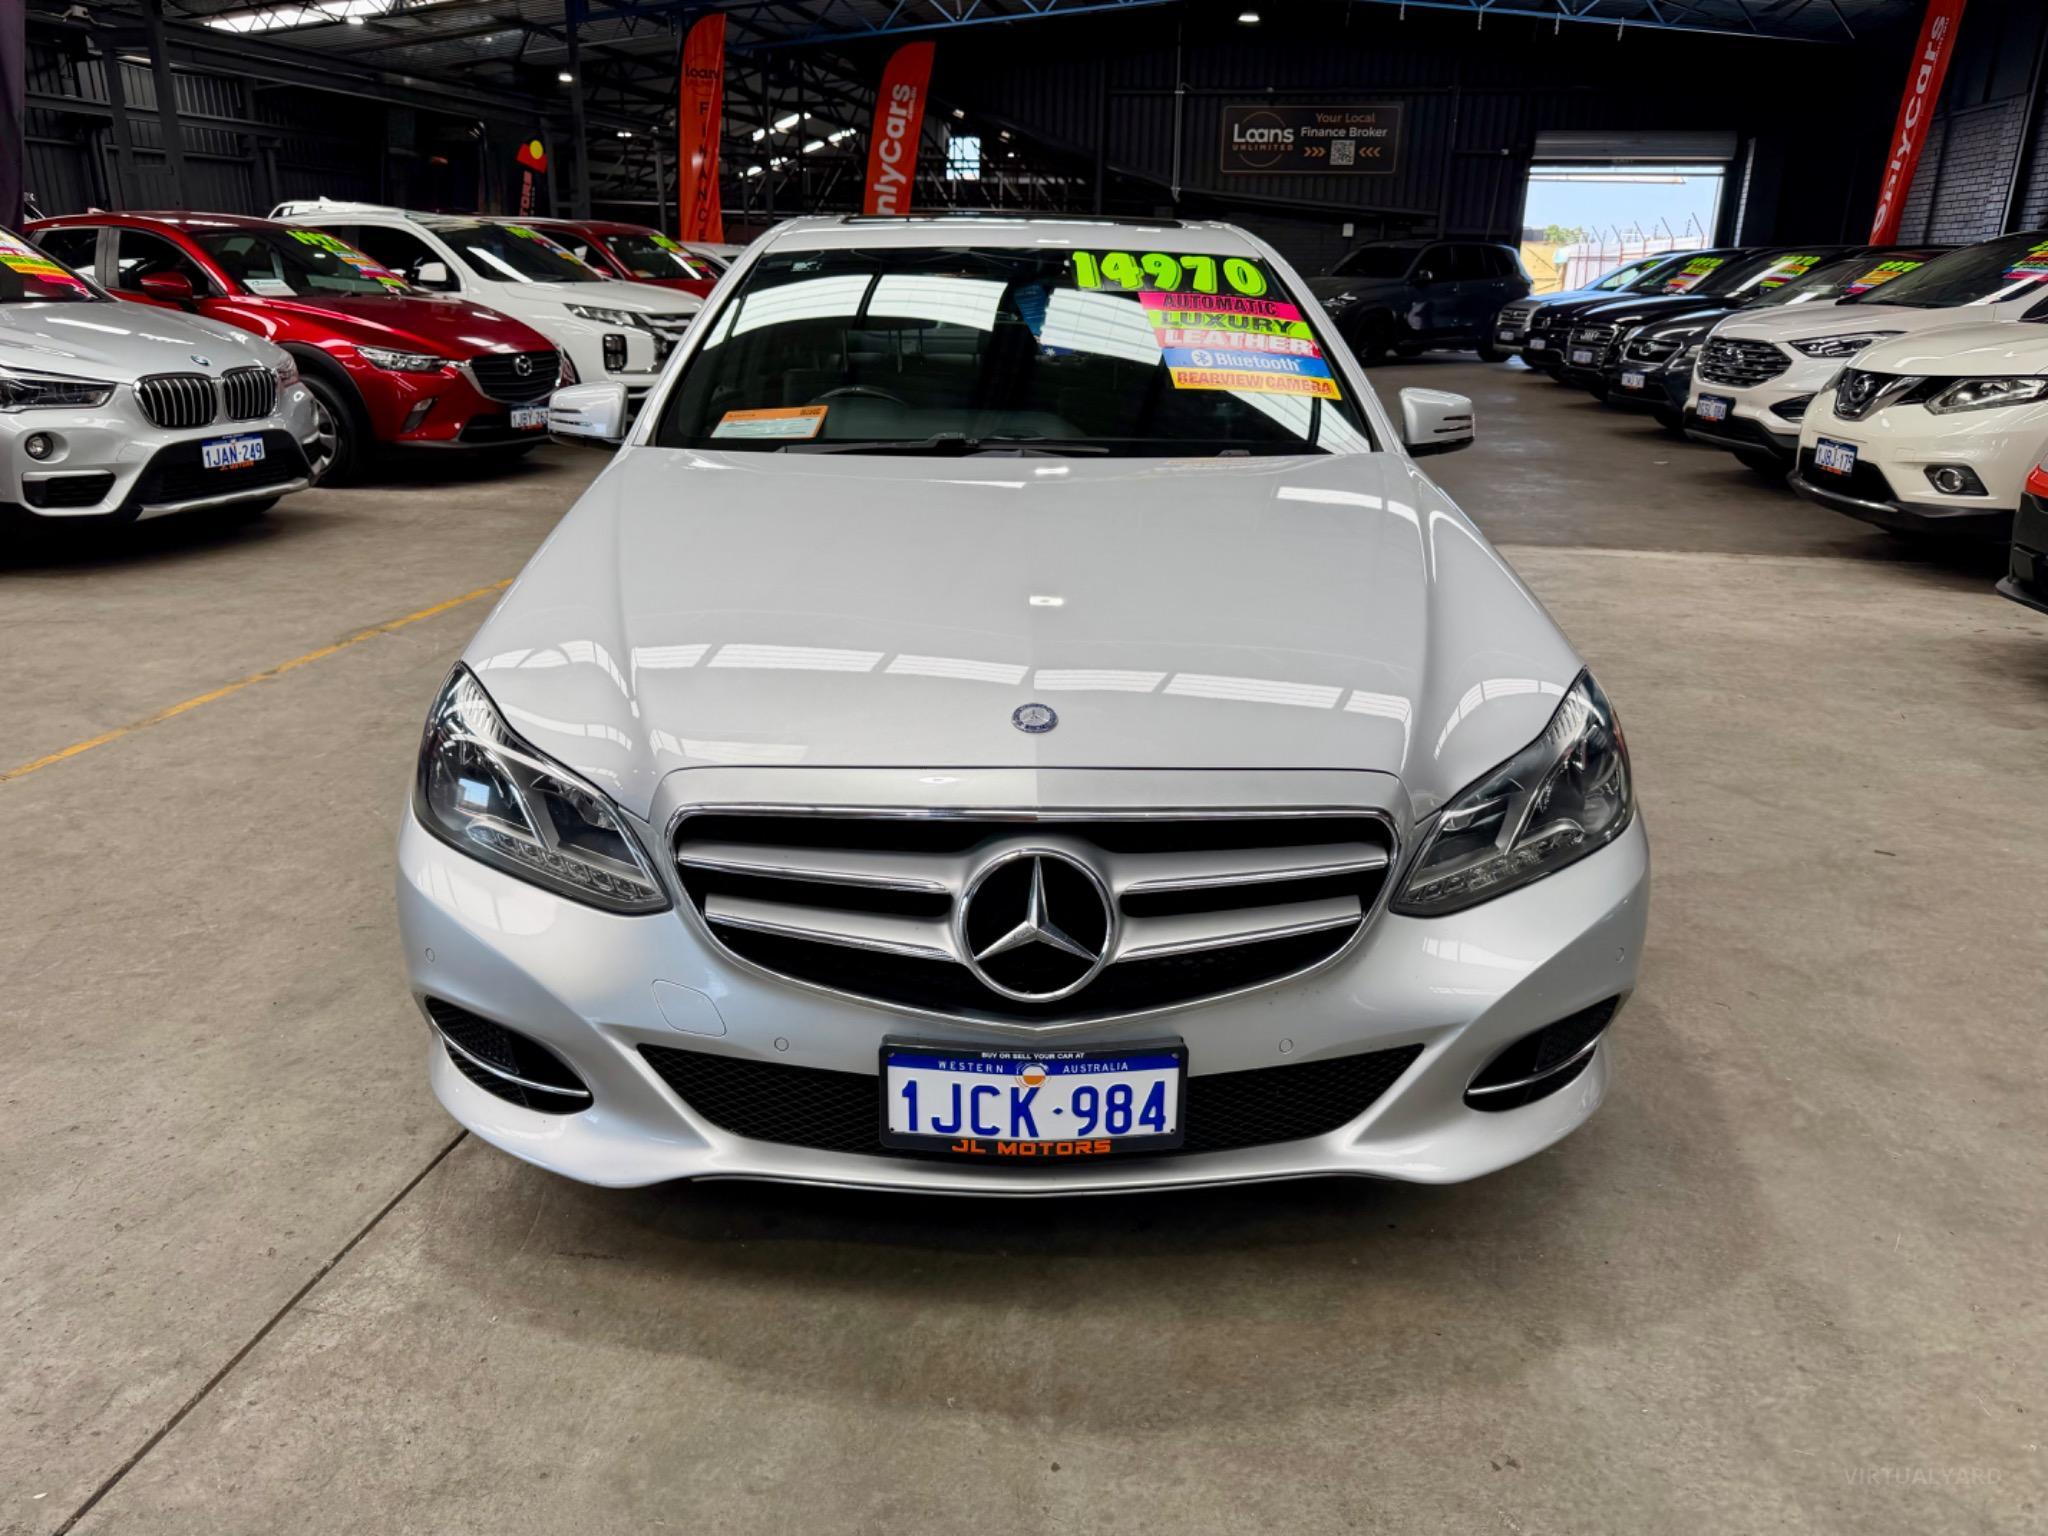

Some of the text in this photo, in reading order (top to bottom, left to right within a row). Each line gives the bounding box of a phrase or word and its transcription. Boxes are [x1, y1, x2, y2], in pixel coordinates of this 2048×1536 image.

[1316, 112, 1376, 123] Your Local
[1233, 123, 1295, 143] Loans
[1301, 127, 1388, 137] Finance Broker
[1073, 251, 1267, 297] 14970
[1163, 293, 1277, 315] AUTOMATIC
[1162, 312, 1294, 334] LUXURY
[1165, 329, 1313, 356] LEATHER
[1216, 352, 1300, 371] Bluetooth
[1177, 371, 1332, 394] REARVIEW CAMERA
[938, 1061, 1129, 1074] WESTERN AUSTRALIA
[952, 1139, 1112, 1155] JL MOTORS
